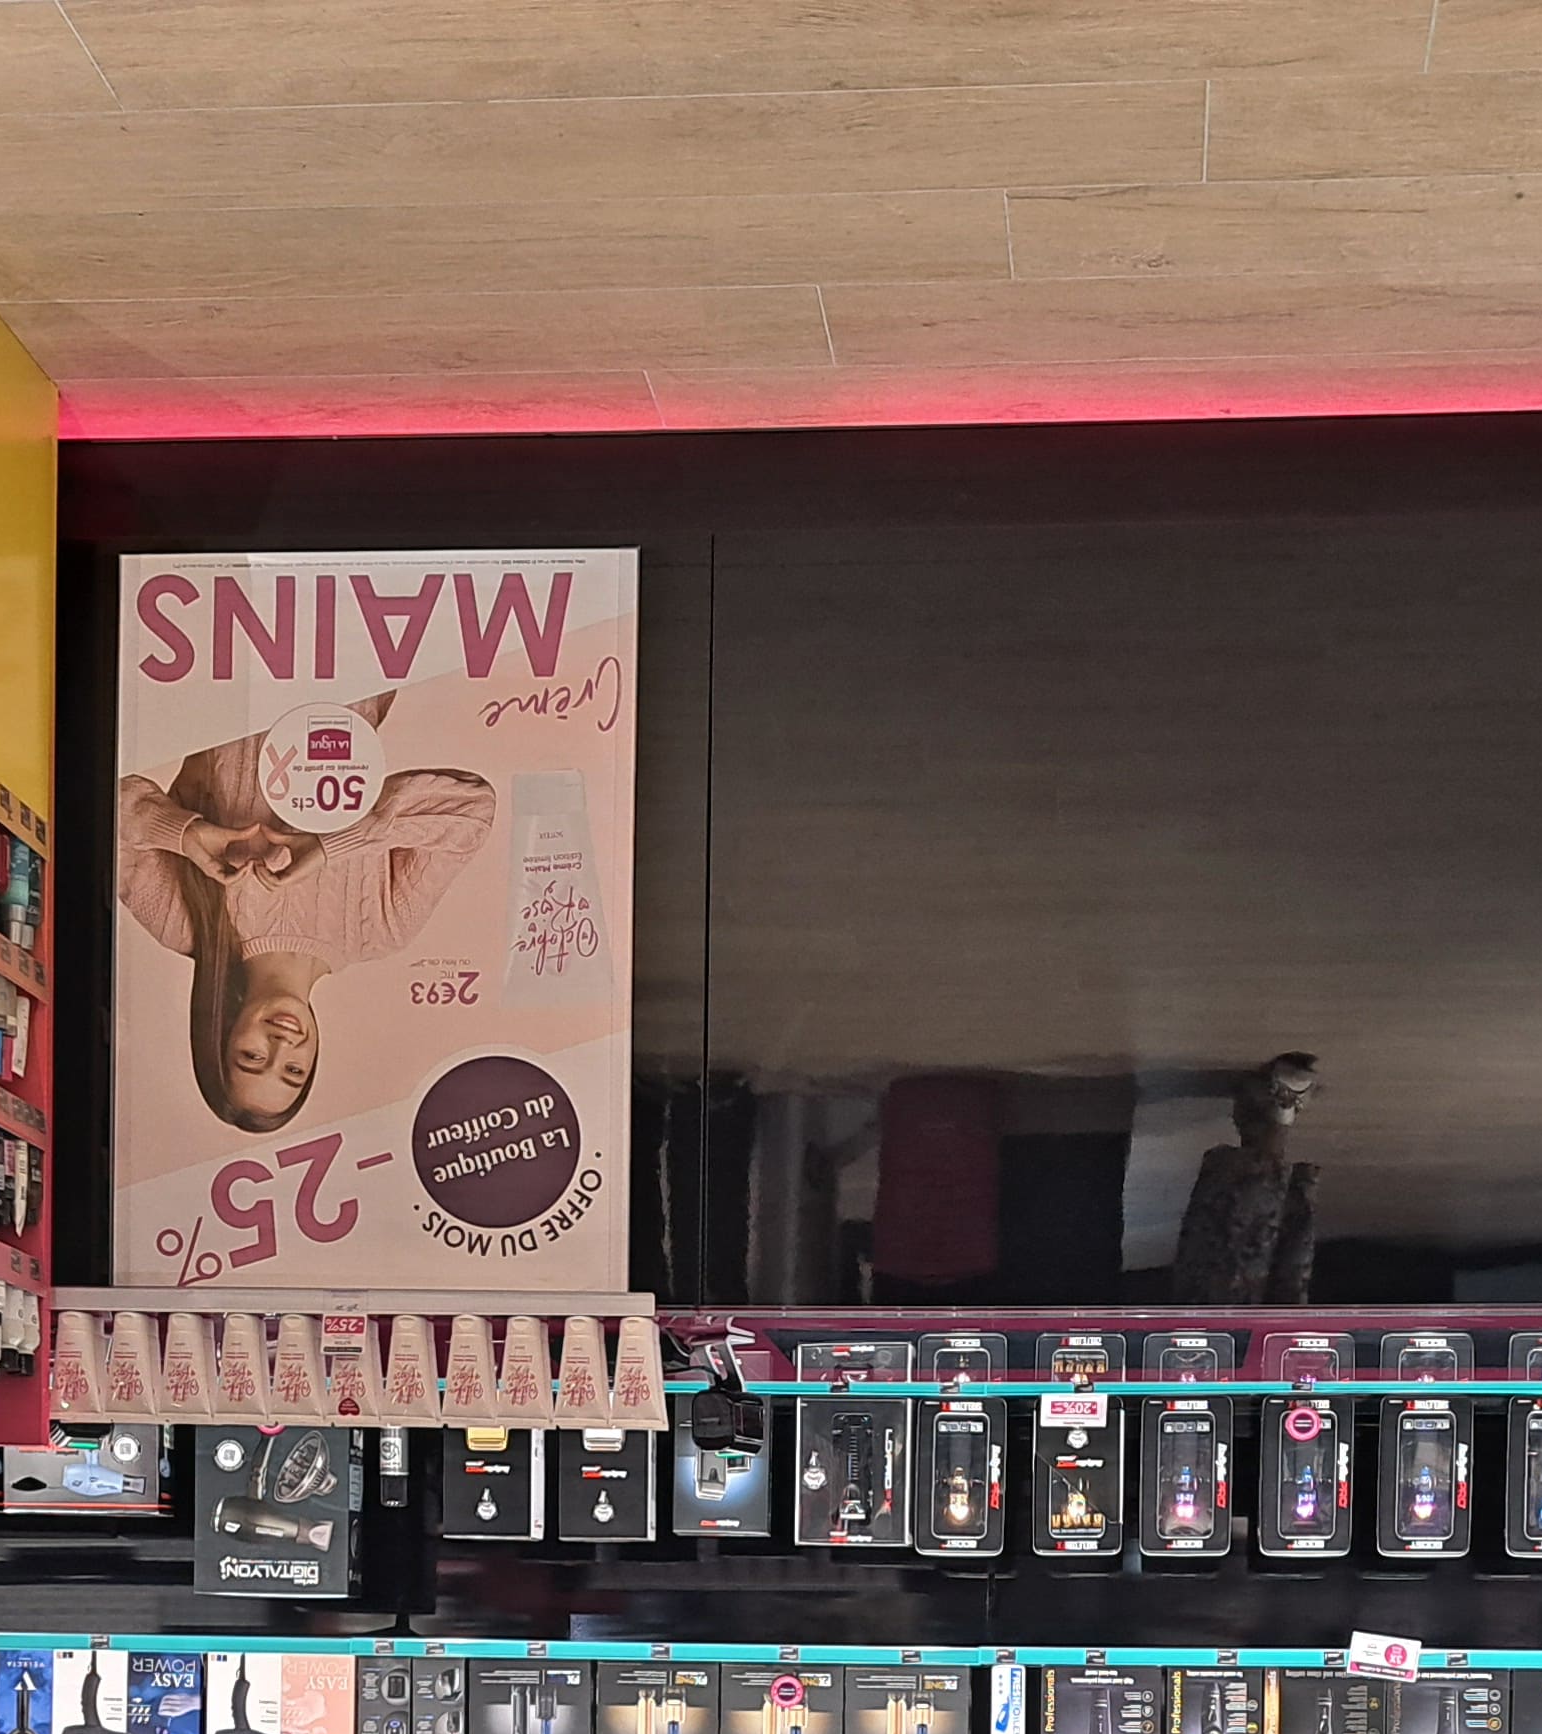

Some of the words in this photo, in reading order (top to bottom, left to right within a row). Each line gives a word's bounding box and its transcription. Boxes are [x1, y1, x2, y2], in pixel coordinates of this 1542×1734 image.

[135, 571, 574, 683] MAINS
[478, 656, 621, 732] Crème
[525, 864, 550, 873] Mains
[511, 919, 599, 976] Octobre
[410, 970, 480, 1005] 2€93
[523, 1093, 556, 1122] du
[424, 1106, 520, 1151] Coiffeur
[541, 1126, 571, 1154] La
[432, 1134, 537, 1185] Boutique
[155, 1133, 394, 1287] -25%
[541, 1169, 602, 1241] OFFRE
[421, 1209, 492, 1257] MOIS
[500, 1229, 538, 1257] DU
[326, 1318, 364, 1332] -25%
[132, 1658, 196, 1672] POWER
[151, 1673, 194, 1688] EASY
[305, 1676, 347, 1690] EASY
